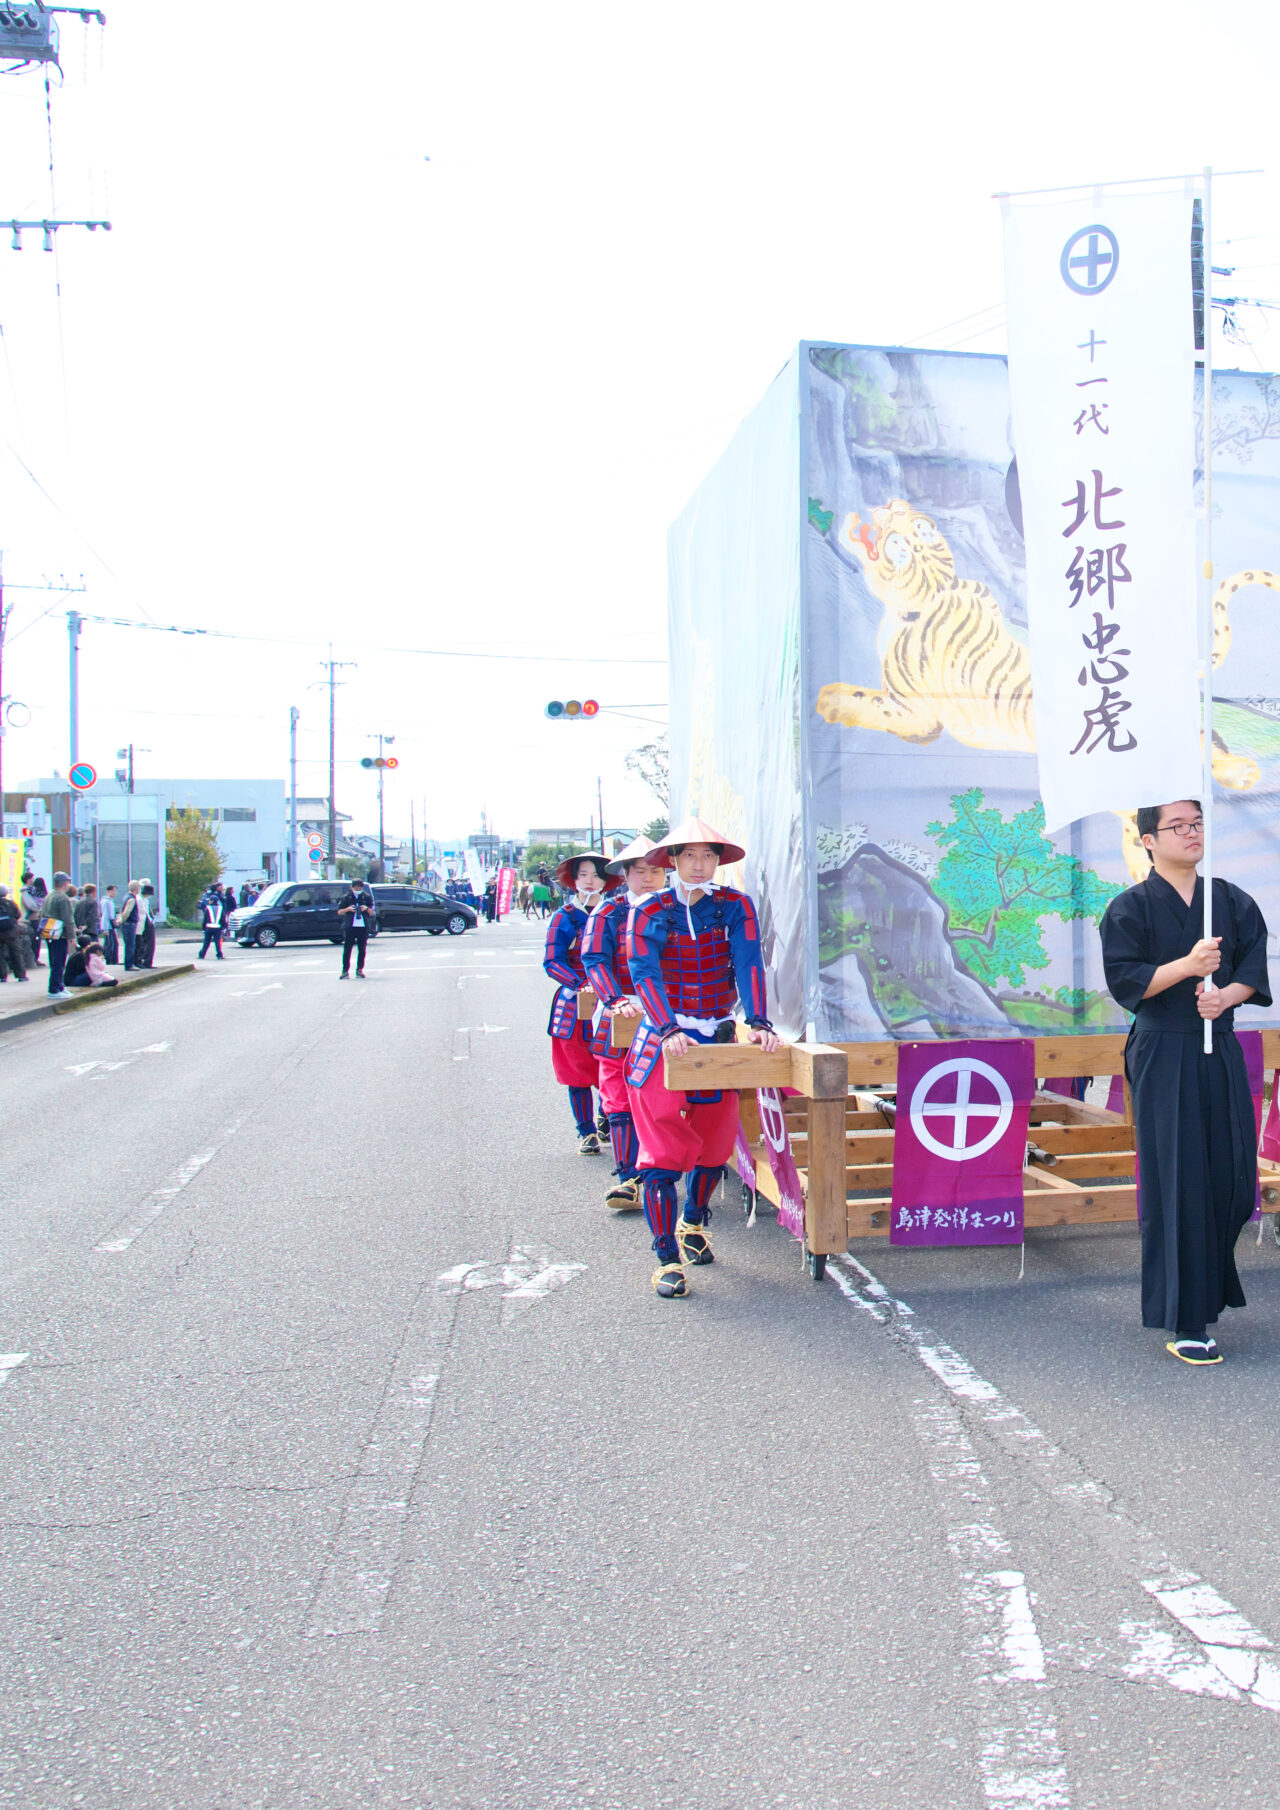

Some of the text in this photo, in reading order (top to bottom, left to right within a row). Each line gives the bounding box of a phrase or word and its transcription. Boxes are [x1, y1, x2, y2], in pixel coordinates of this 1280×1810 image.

[1060, 328, 1139, 756] 十一代 北郷忠虎
[895, 1205, 1016, 1231] 島津発祥まつり
